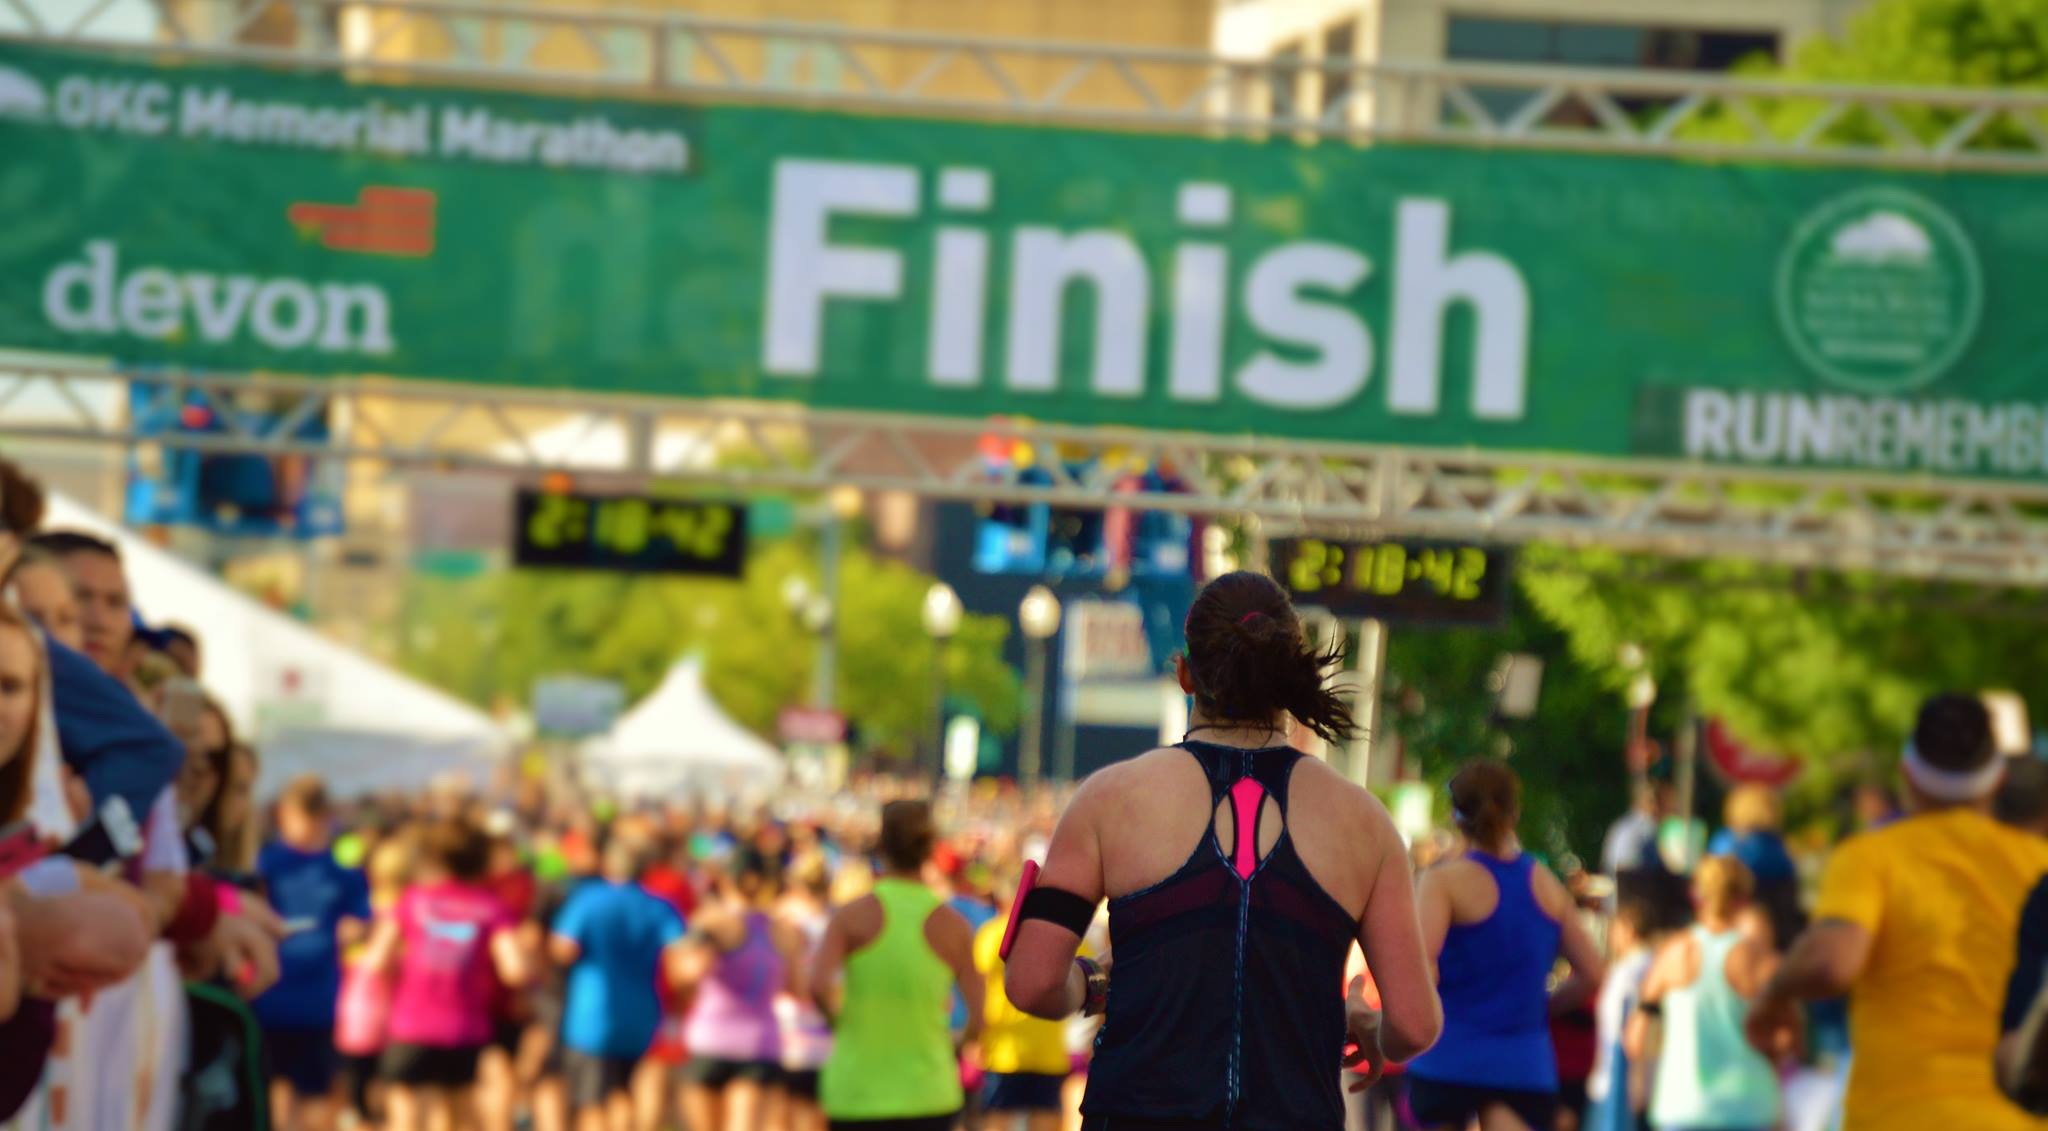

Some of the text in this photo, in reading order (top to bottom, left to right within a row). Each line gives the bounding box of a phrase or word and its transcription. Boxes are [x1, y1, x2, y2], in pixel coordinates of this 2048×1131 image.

[57, 76, 688, 172] OKC Memorial Marathon
[43, 241, 393, 353] devon
[763, 158, 1529, 419] Finish
